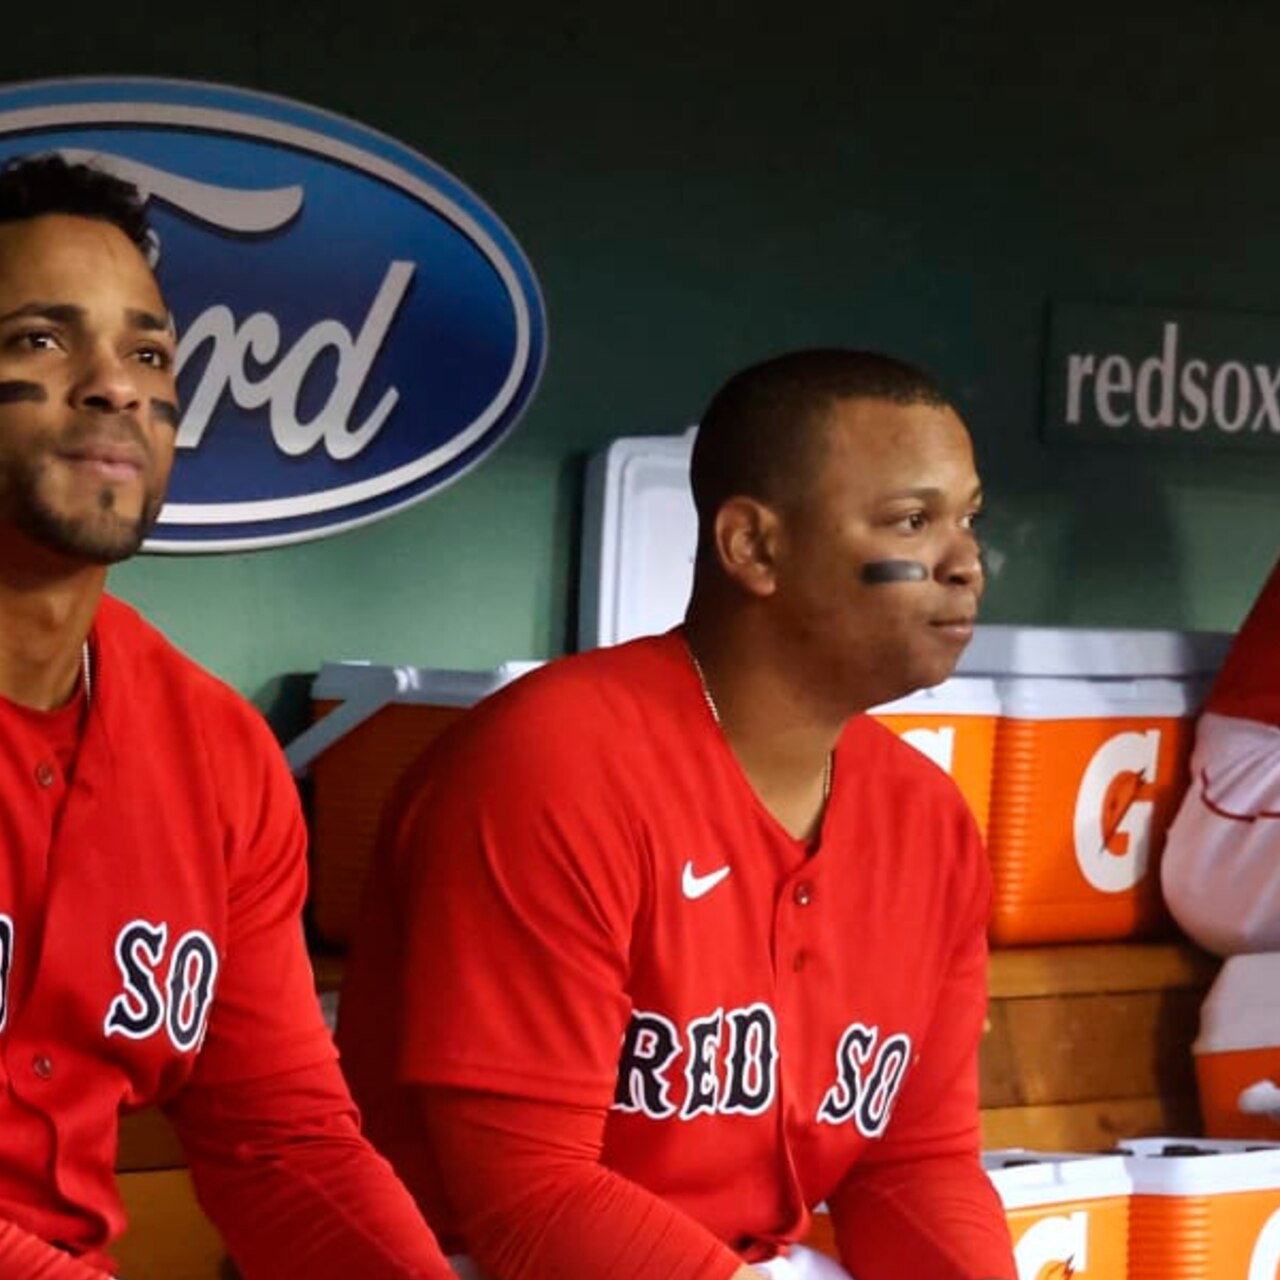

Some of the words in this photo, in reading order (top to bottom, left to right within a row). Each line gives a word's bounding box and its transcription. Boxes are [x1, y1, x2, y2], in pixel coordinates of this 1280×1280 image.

[1073, 728, 1161, 893] G
[104, 920, 218, 1053] SO
[612, 1003, 778, 1120] RED
[817, 1024, 911, 1138] SO
